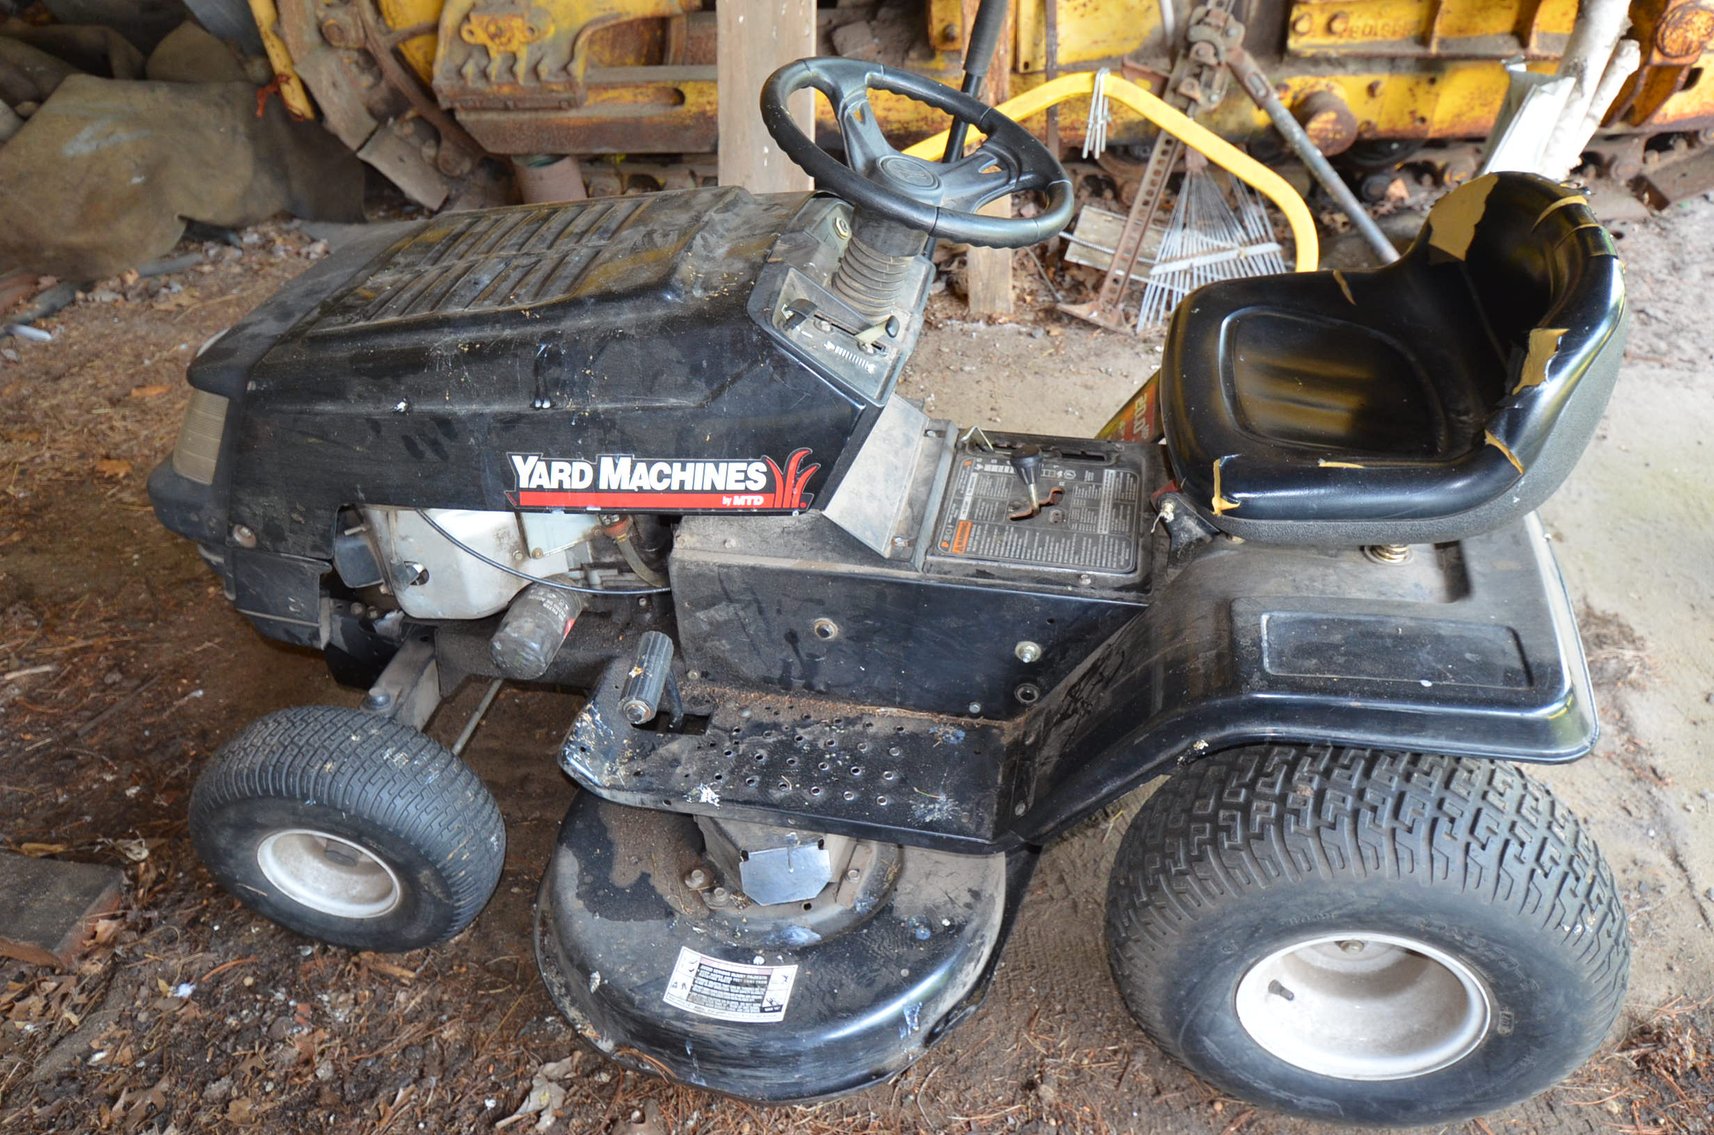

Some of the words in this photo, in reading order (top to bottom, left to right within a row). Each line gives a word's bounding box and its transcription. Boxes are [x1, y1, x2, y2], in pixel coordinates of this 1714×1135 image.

[512, 455, 593, 489] YARD
[599, 457, 767, 491] MACHINES
[722, 496, 732, 506] by
[733, 495, 764, 505] MTD
